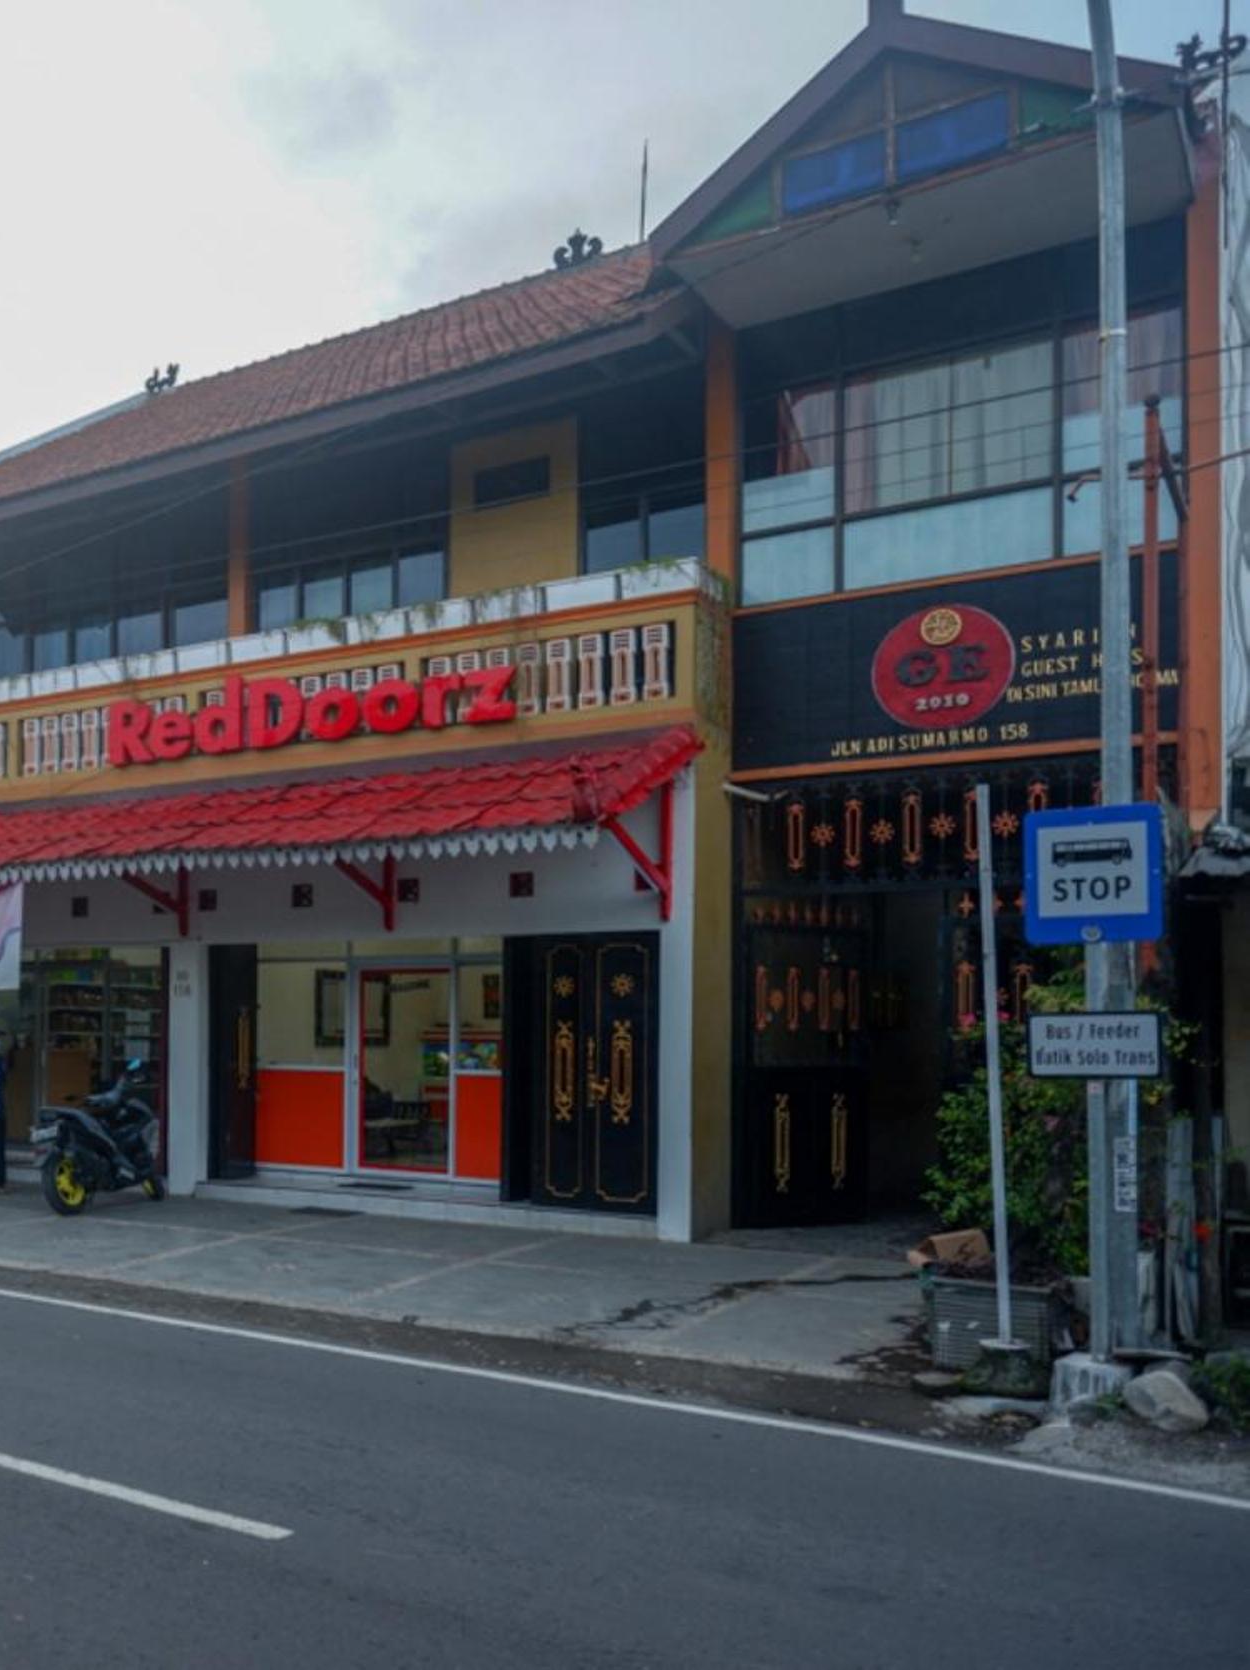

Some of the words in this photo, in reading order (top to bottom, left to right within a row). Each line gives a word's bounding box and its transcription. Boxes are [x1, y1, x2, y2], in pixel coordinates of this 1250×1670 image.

[1020, 655, 1080, 678] GUEST
[107, 664, 519, 768] RedDoorz
[829, 738, 862, 758] JLN
[866, 735, 895, 754] ADI
[898, 726, 989, 750] SUMARMO
[999, 722, 1030, 741] 158
[1052, 875, 1132, 902] STOP
[1046, 1023, 1072, 1041] Bus
[1090, 1021, 1141, 1041] Feeder
[1077, 1048, 1110, 1066] Solo
[1114, 1048, 1156, 1066] Trans
